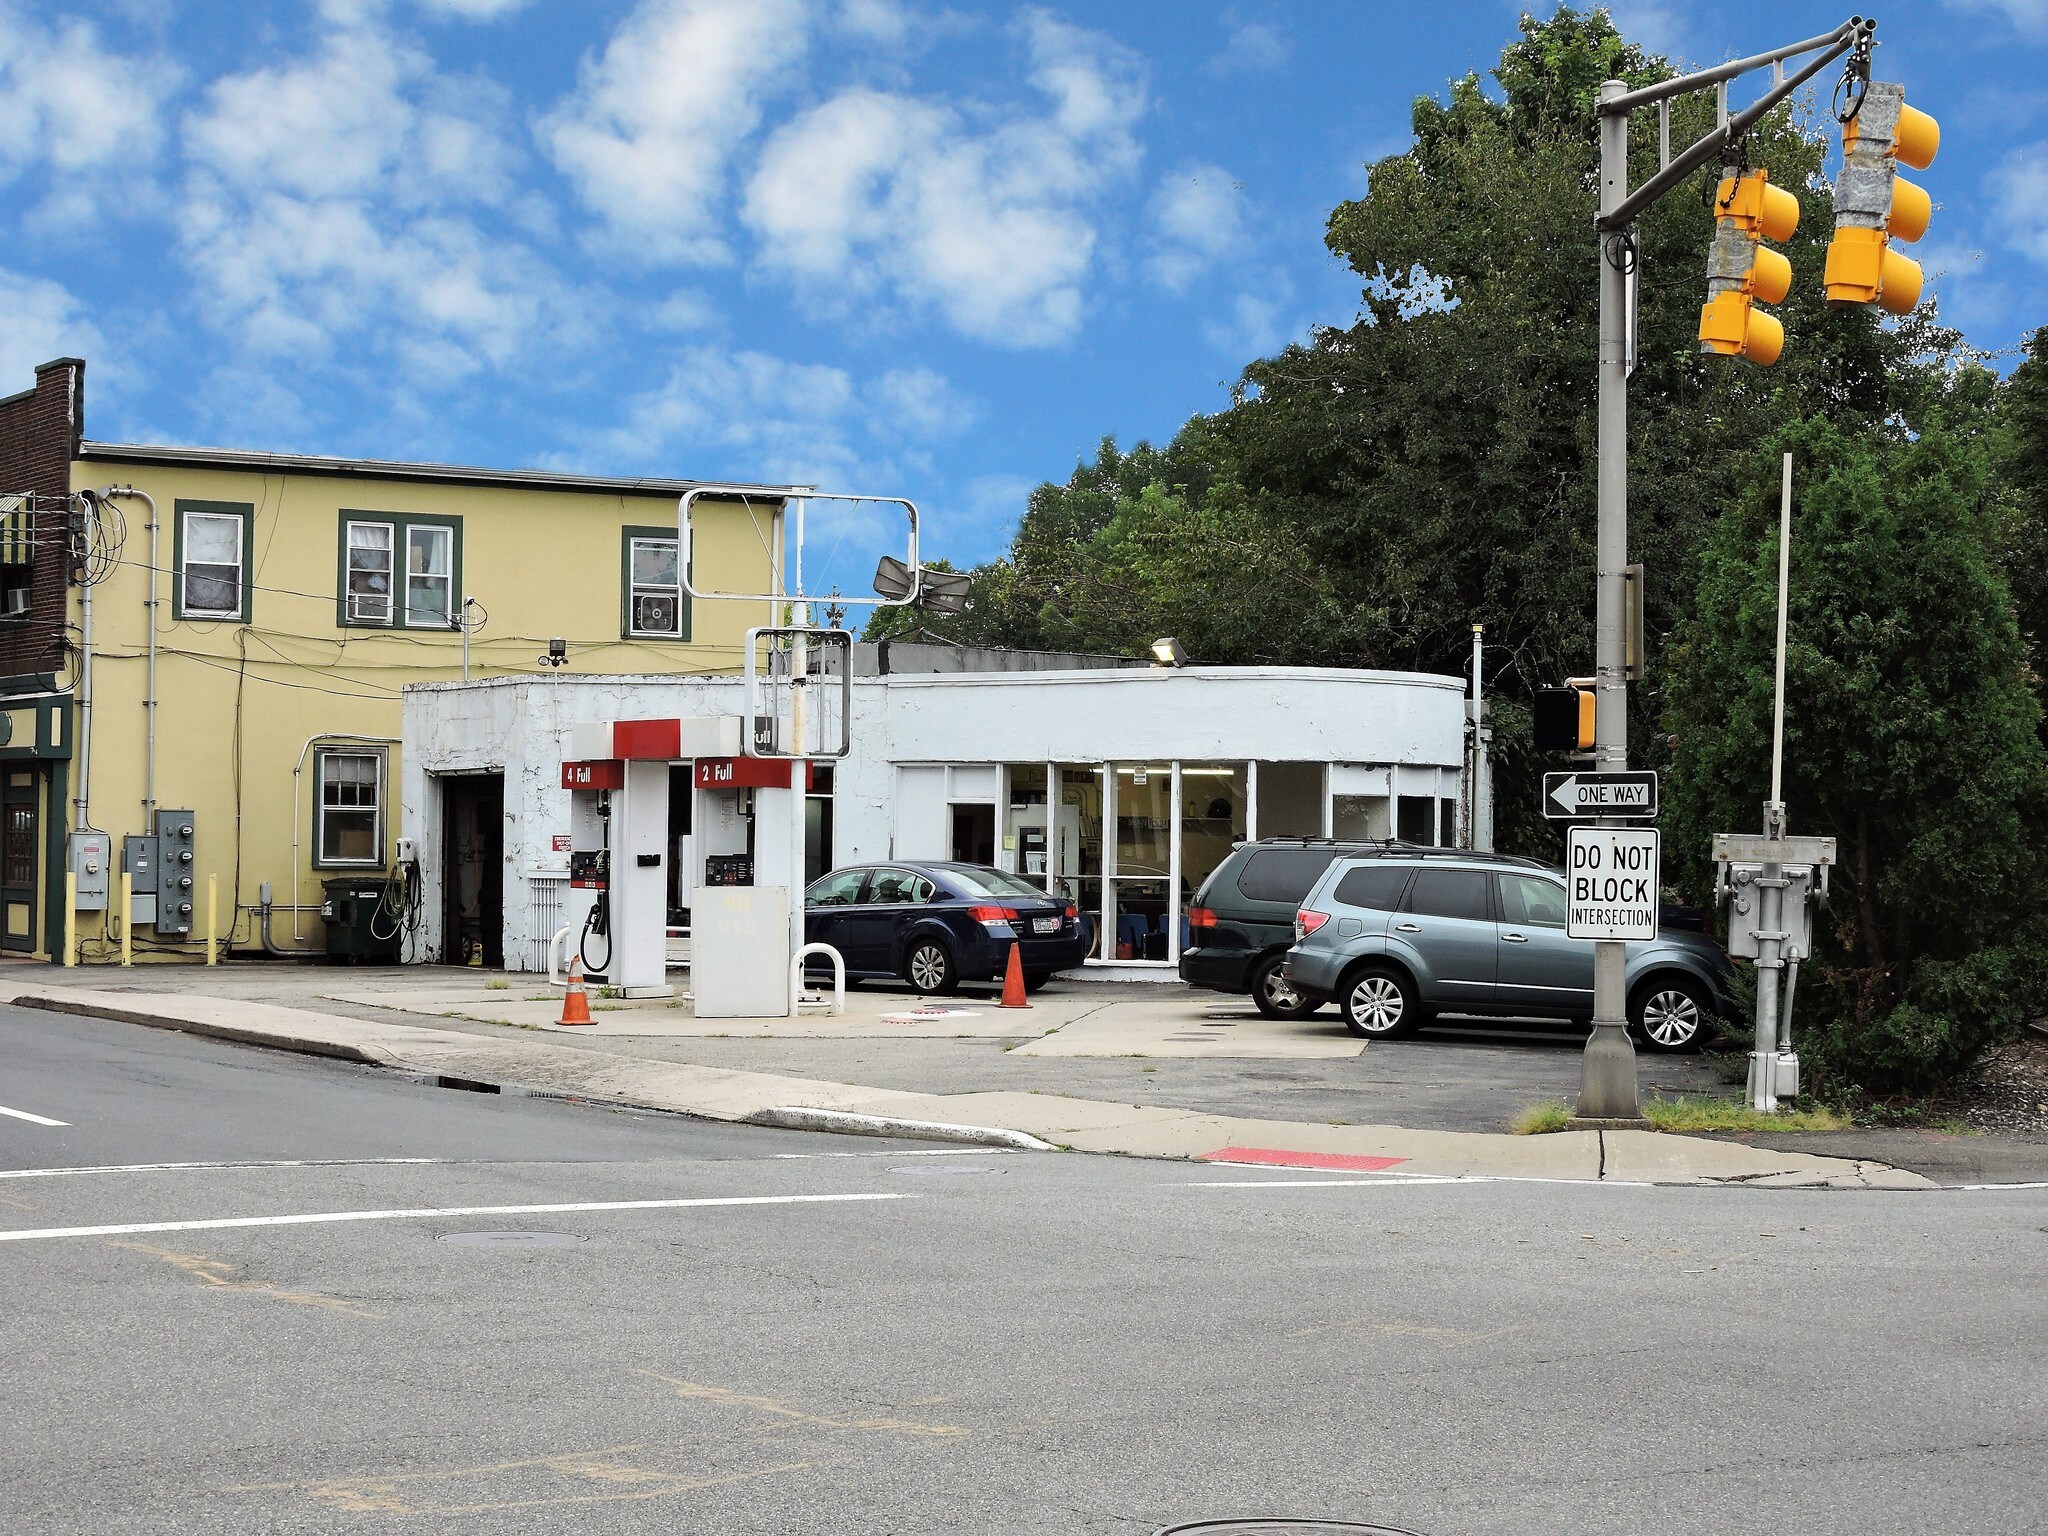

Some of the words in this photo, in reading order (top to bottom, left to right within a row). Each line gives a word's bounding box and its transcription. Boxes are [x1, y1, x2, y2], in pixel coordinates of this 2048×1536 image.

[567, 767, 573, 782] 4
[576, 766, 591, 783] Full
[702, 765, 709, 782] 2
[714, 763, 733, 781] Full
[1578, 786, 1608, 803] ONE
[1613, 786, 1644, 803] WAY
[1574, 844, 1601, 869] DO
[1613, 846, 1653, 870] NOT
[1576, 877, 1648, 903] BLOCK
[1571, 908, 1652, 926] INTERSECTION
